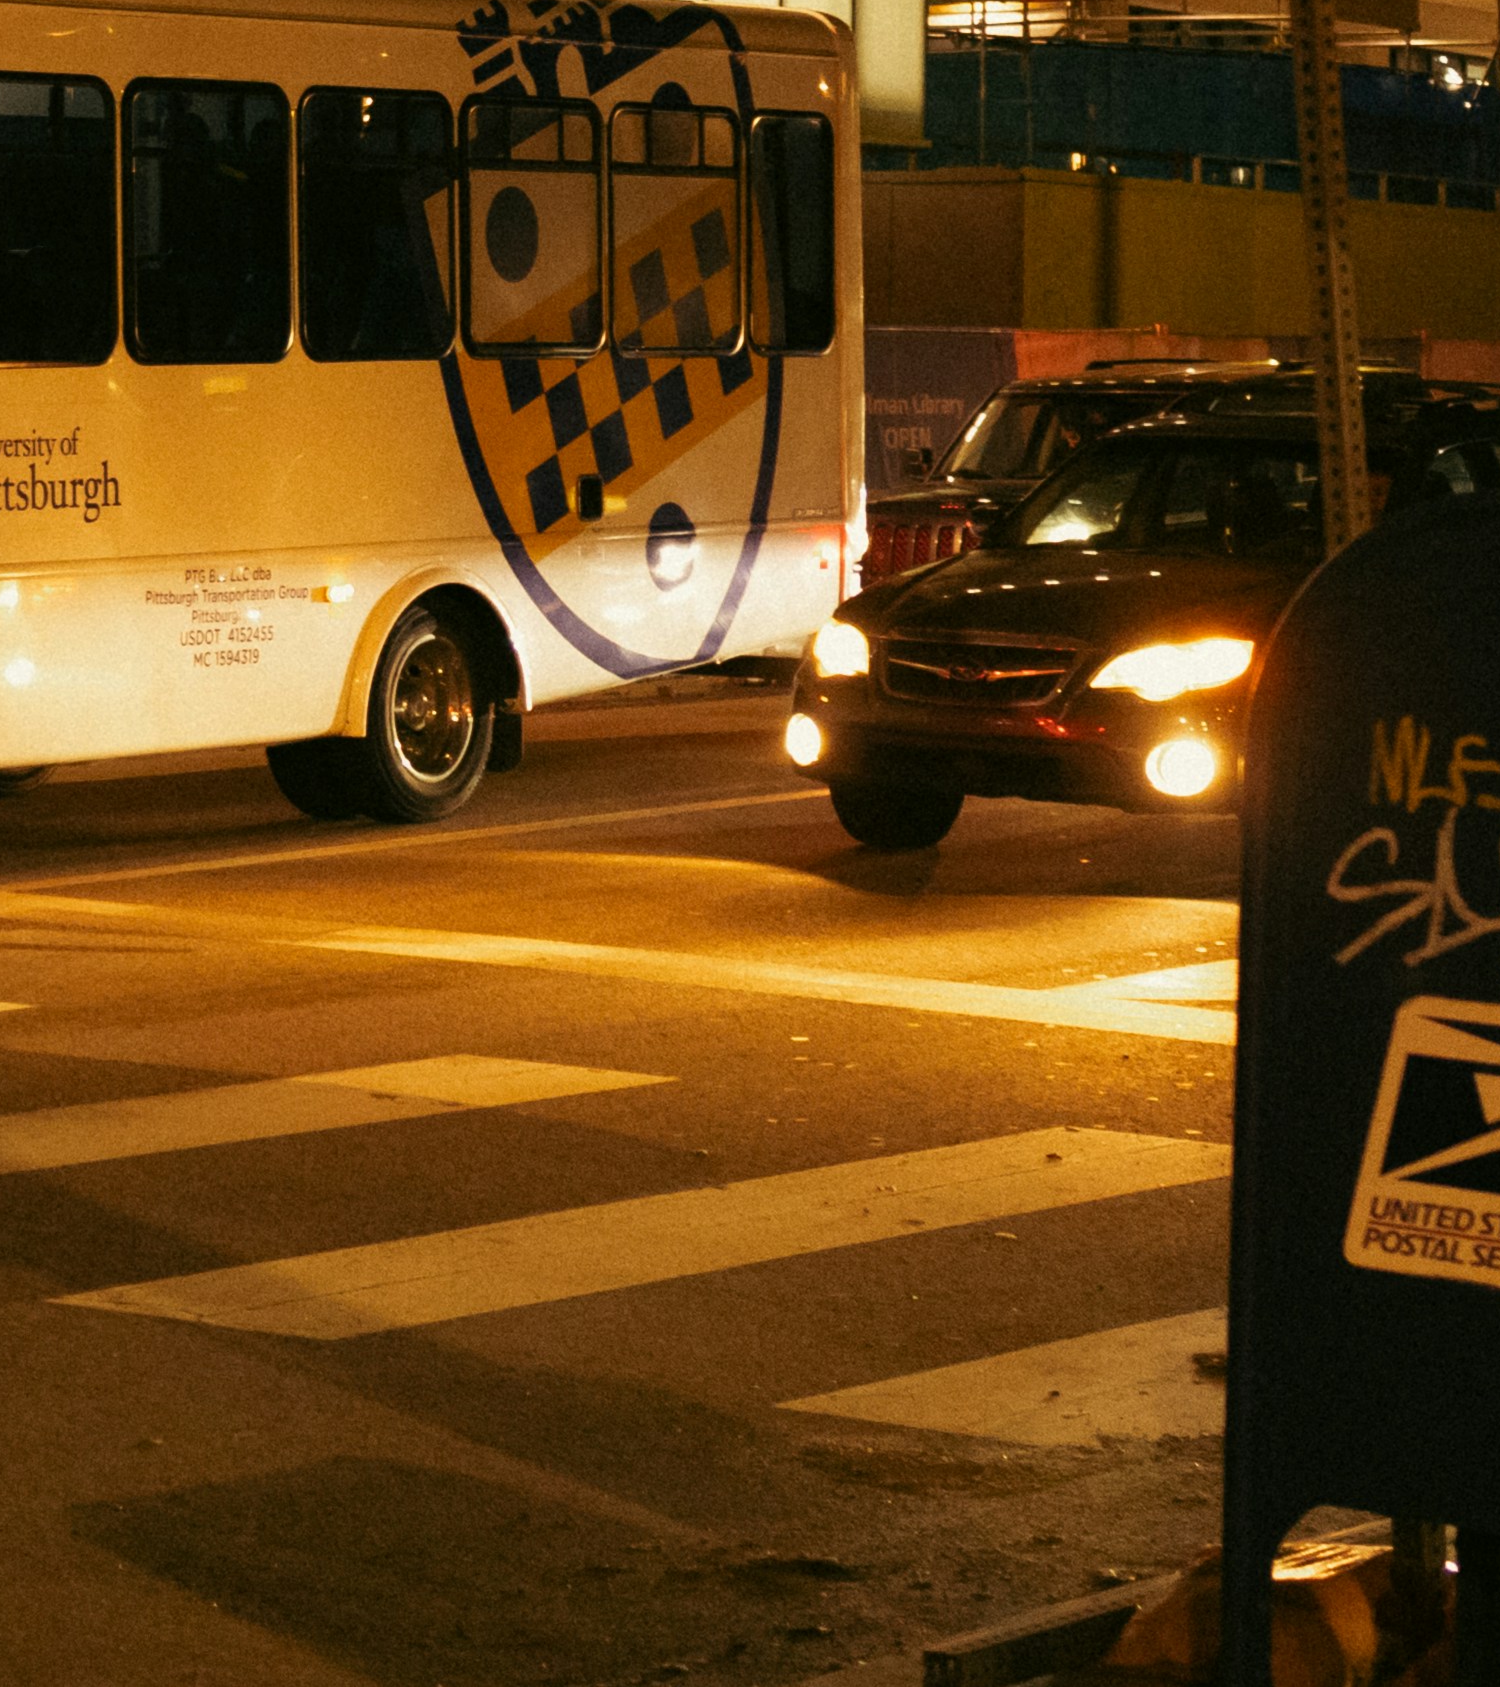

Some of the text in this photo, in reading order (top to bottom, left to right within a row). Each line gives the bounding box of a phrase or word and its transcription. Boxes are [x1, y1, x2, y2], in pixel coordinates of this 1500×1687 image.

[60, 426, 80, 456] of
[184, 569, 206, 584] PTG
[252, 567, 272, 582] dba
[145, 584, 309, 607] Pittsburgh Transportation Group
[191, 609, 242, 625] Pittsburg
[180, 625, 274, 646] USDOT 4152455
[193, 648, 260, 667] MC 1594319
[1369, 1196, 1475, 1232] UNITED
[1363, 1227, 1463, 1264] POSTAL
